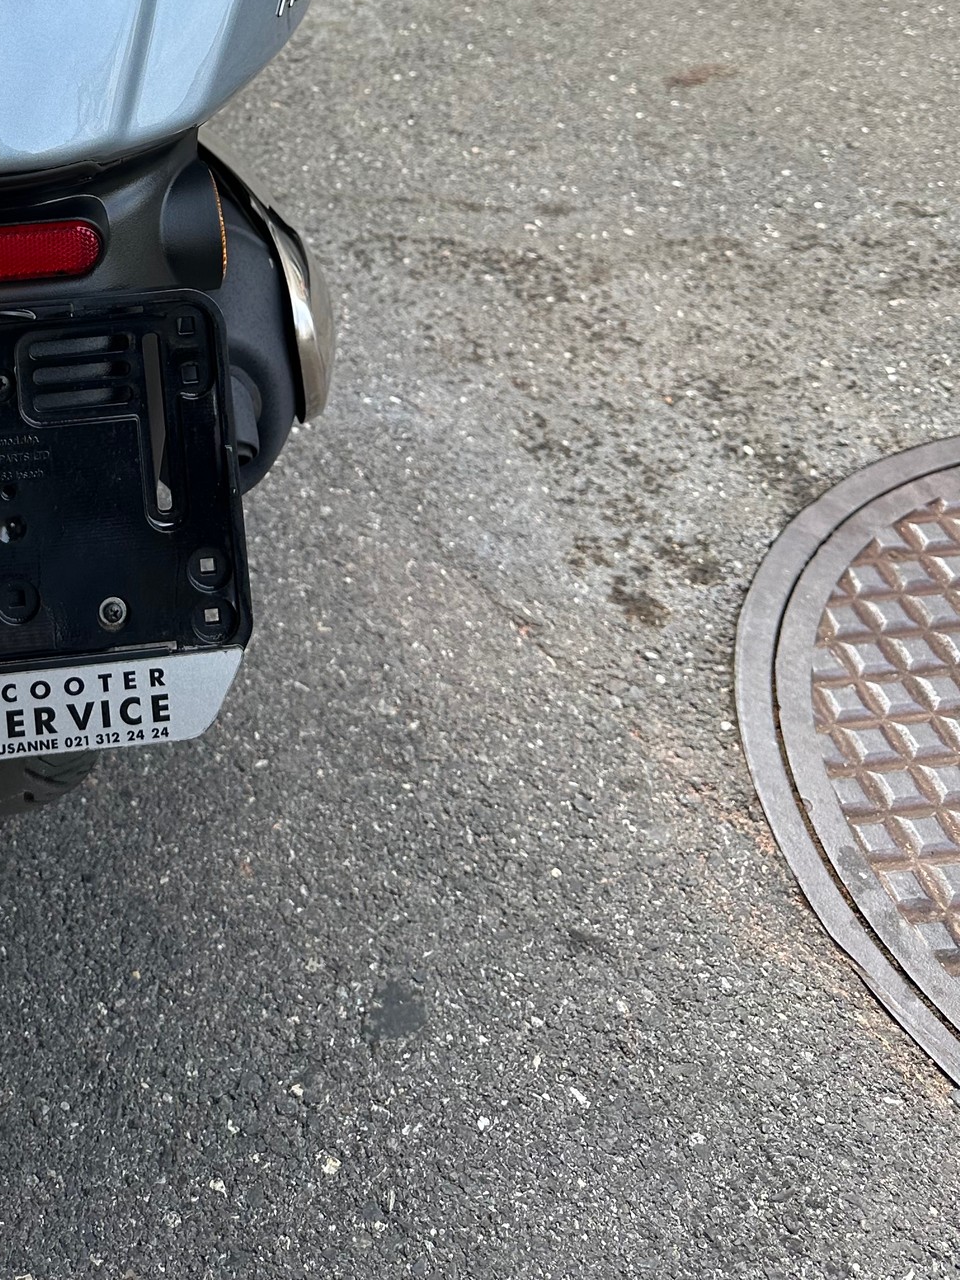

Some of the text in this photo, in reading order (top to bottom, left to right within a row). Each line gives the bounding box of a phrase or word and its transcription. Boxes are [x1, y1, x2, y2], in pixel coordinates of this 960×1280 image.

[64, 735, 90, 748] 021
[95, 731, 121, 745] 312
[126, 728, 145, 742] 24
[151, 726, 170, 739] 24
